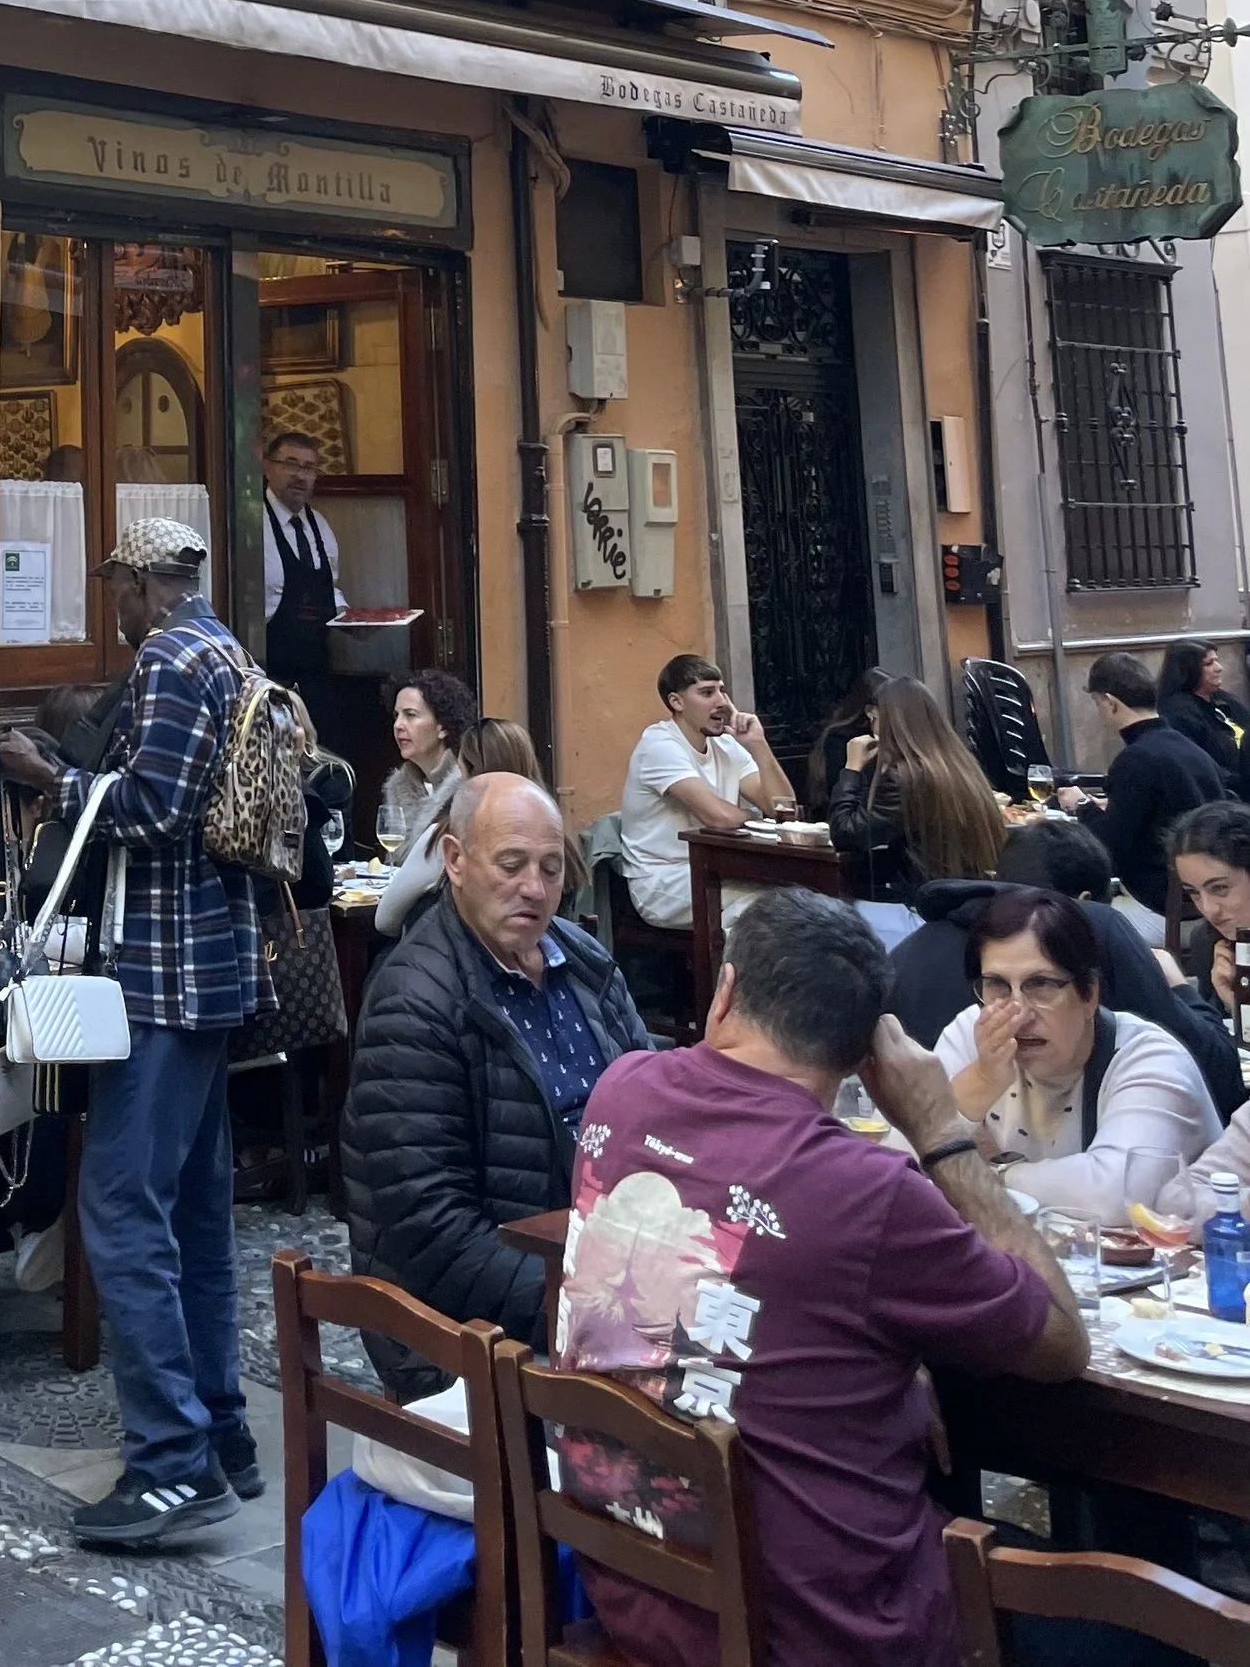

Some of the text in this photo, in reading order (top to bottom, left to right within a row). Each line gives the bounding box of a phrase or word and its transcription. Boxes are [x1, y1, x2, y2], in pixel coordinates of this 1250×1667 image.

[600, 74, 787, 126] Bodegas Castañeda
[1035, 102, 1212, 161] Bodegas
[86, 135, 391, 204] Vinos de Montilla
[1017, 167, 1212, 223] Castañeda
[673, 1278, 761, 1425] 東京
